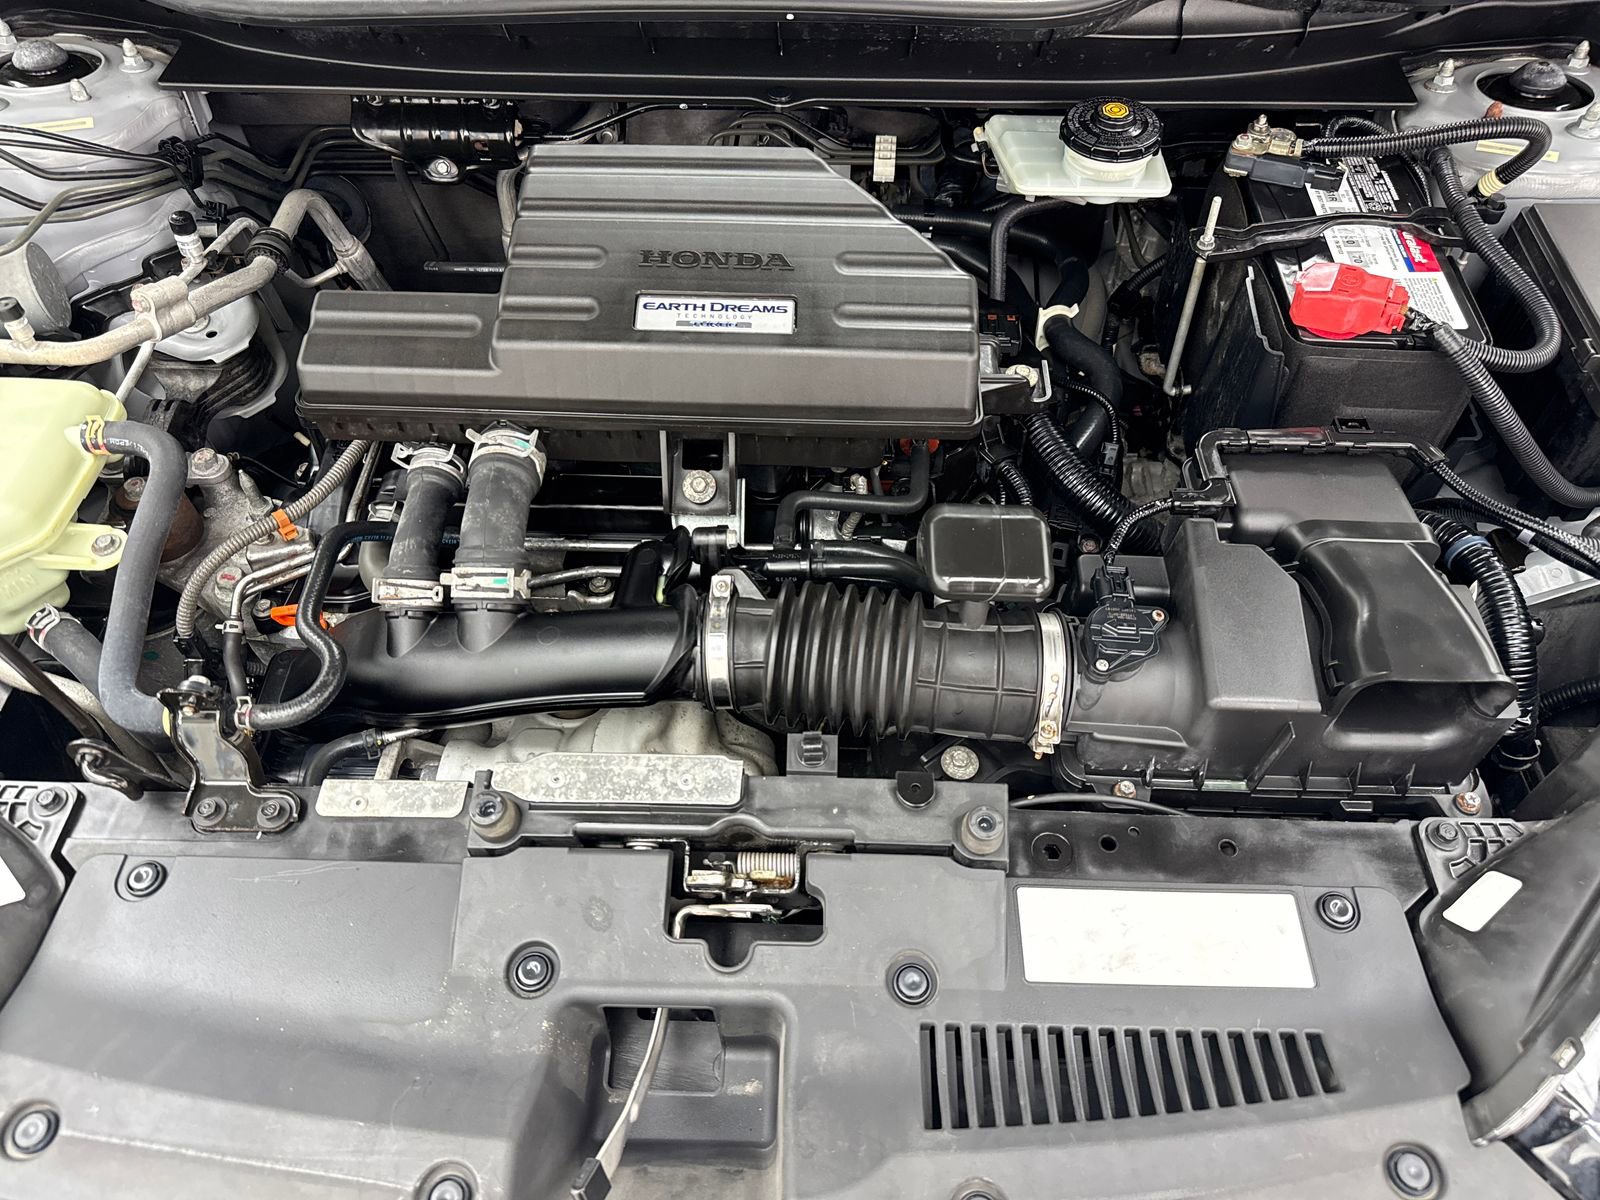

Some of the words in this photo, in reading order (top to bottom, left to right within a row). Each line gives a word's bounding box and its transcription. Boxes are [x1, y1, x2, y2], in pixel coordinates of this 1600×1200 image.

[1402, 232, 1429, 265] uralast
[639, 250, 794, 271] HONDA
[643, 302, 705, 312] EARTH
[710, 302, 788, 313] DREAMS
